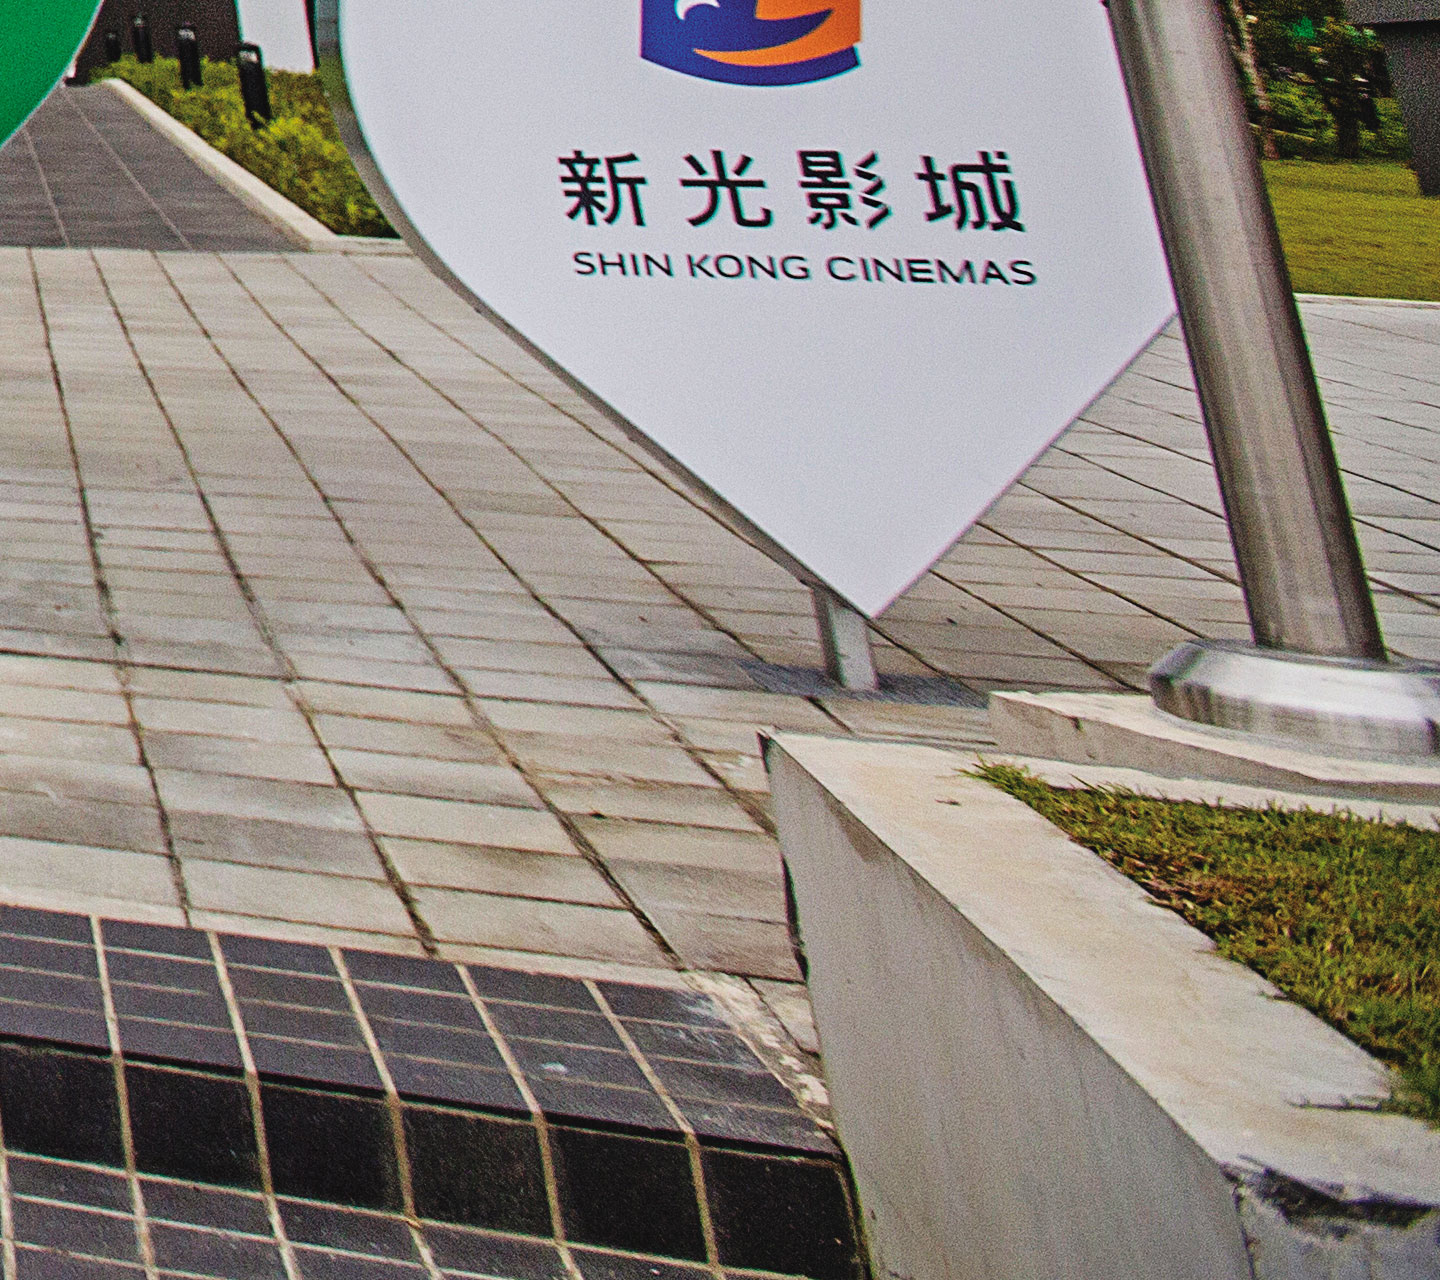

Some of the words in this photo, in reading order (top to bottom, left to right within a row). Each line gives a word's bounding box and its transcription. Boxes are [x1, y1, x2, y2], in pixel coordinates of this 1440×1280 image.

[557, 149, 1026, 232] 新光影城
[573, 251, 673, 278] SHIN
[687, 253, 811, 281] KONG
[826, 256, 1037, 286] CINEMAS
